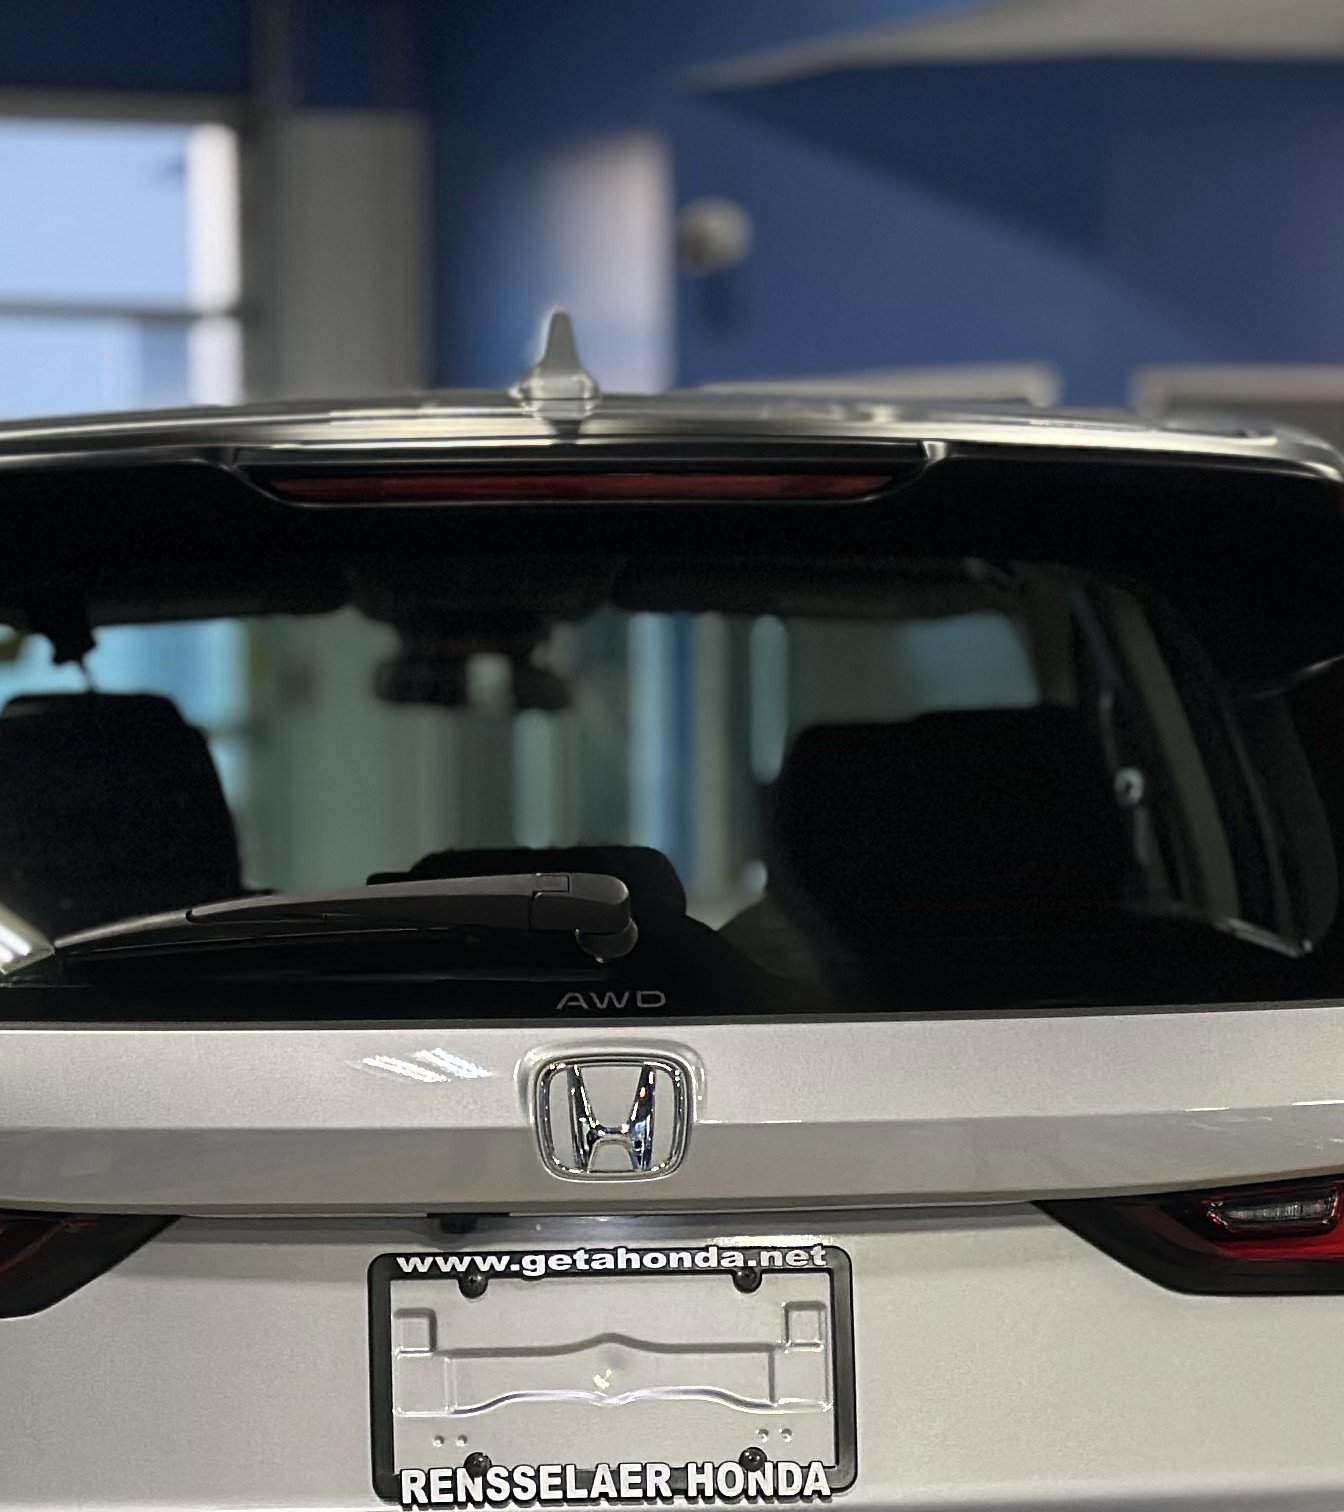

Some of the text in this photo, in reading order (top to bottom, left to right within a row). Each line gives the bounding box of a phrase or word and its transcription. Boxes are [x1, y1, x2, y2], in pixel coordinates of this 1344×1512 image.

[556, 990, 666, 1010] AWD
[396, 1244, 827, 1276] www.getahonda.net
[400, 1461, 832, 1504] RENSSELAER HONDA
